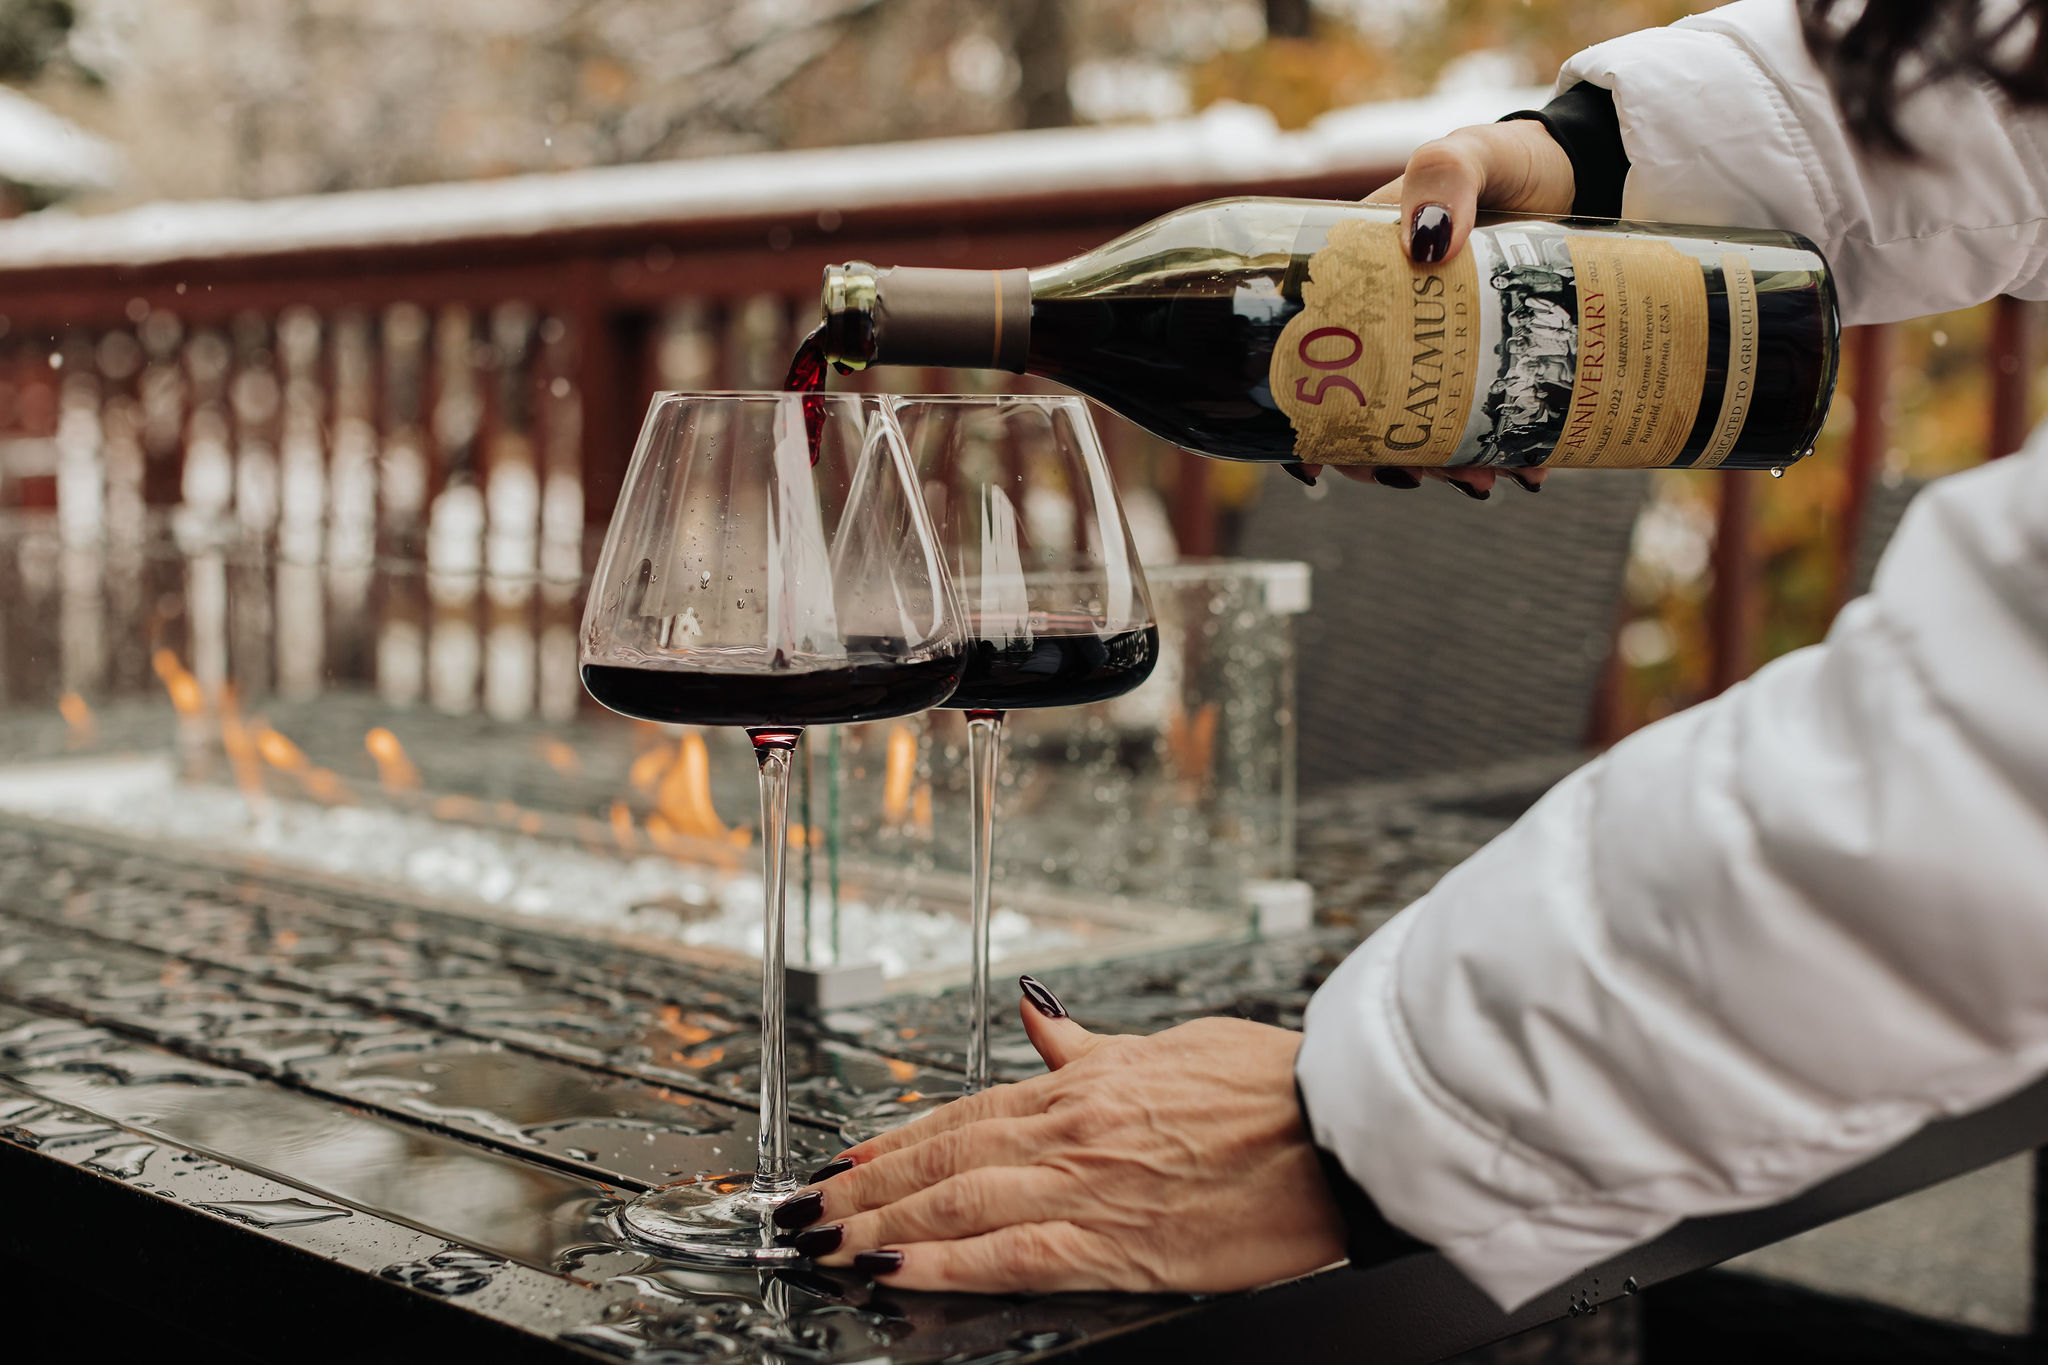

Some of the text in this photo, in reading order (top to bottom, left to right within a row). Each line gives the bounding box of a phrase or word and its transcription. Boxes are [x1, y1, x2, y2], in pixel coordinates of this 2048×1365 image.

[1612, 257, 1630, 317] SAUVIGNON
[1295, 326, 1367, 407] 50
[1384, 275, 1446, 451] CAYMUS
[1434, 283, 1468, 444] VINEYARDS
[1564, 287, 1606, 449] ANNIVERSARY
[1587, 260, 1599, 284] 2022
[1608, 389, 1623, 417] 2022
[1616, 318, 1629, 378] CABERNET
[1621, 296, 1655, 446] Bottled by Caymus Vineyards
[1705, 268, 1753, 466] DEDICATED TO AGRICULTURE
[1594, 425, 1613, 451] VALLEY
